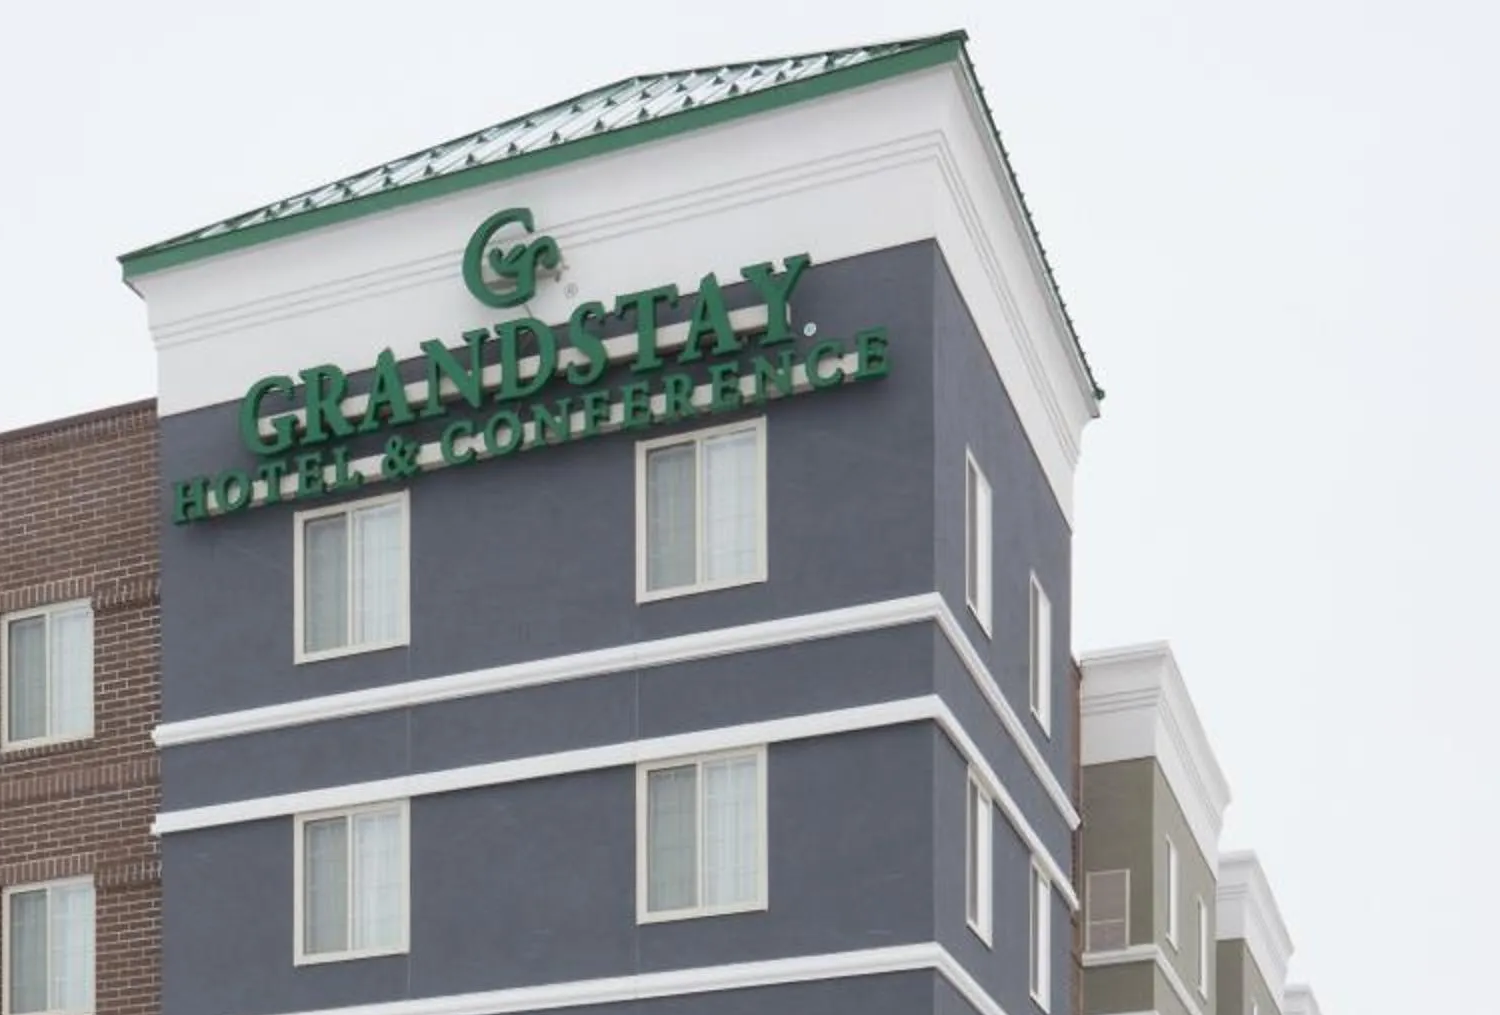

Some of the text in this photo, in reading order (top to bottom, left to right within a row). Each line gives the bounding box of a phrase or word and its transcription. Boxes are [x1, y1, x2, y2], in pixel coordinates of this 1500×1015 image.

[172, 326, 891, 525] HOTEL & CONFERENCE
[238, 254, 811, 457] GRANDSTAY
